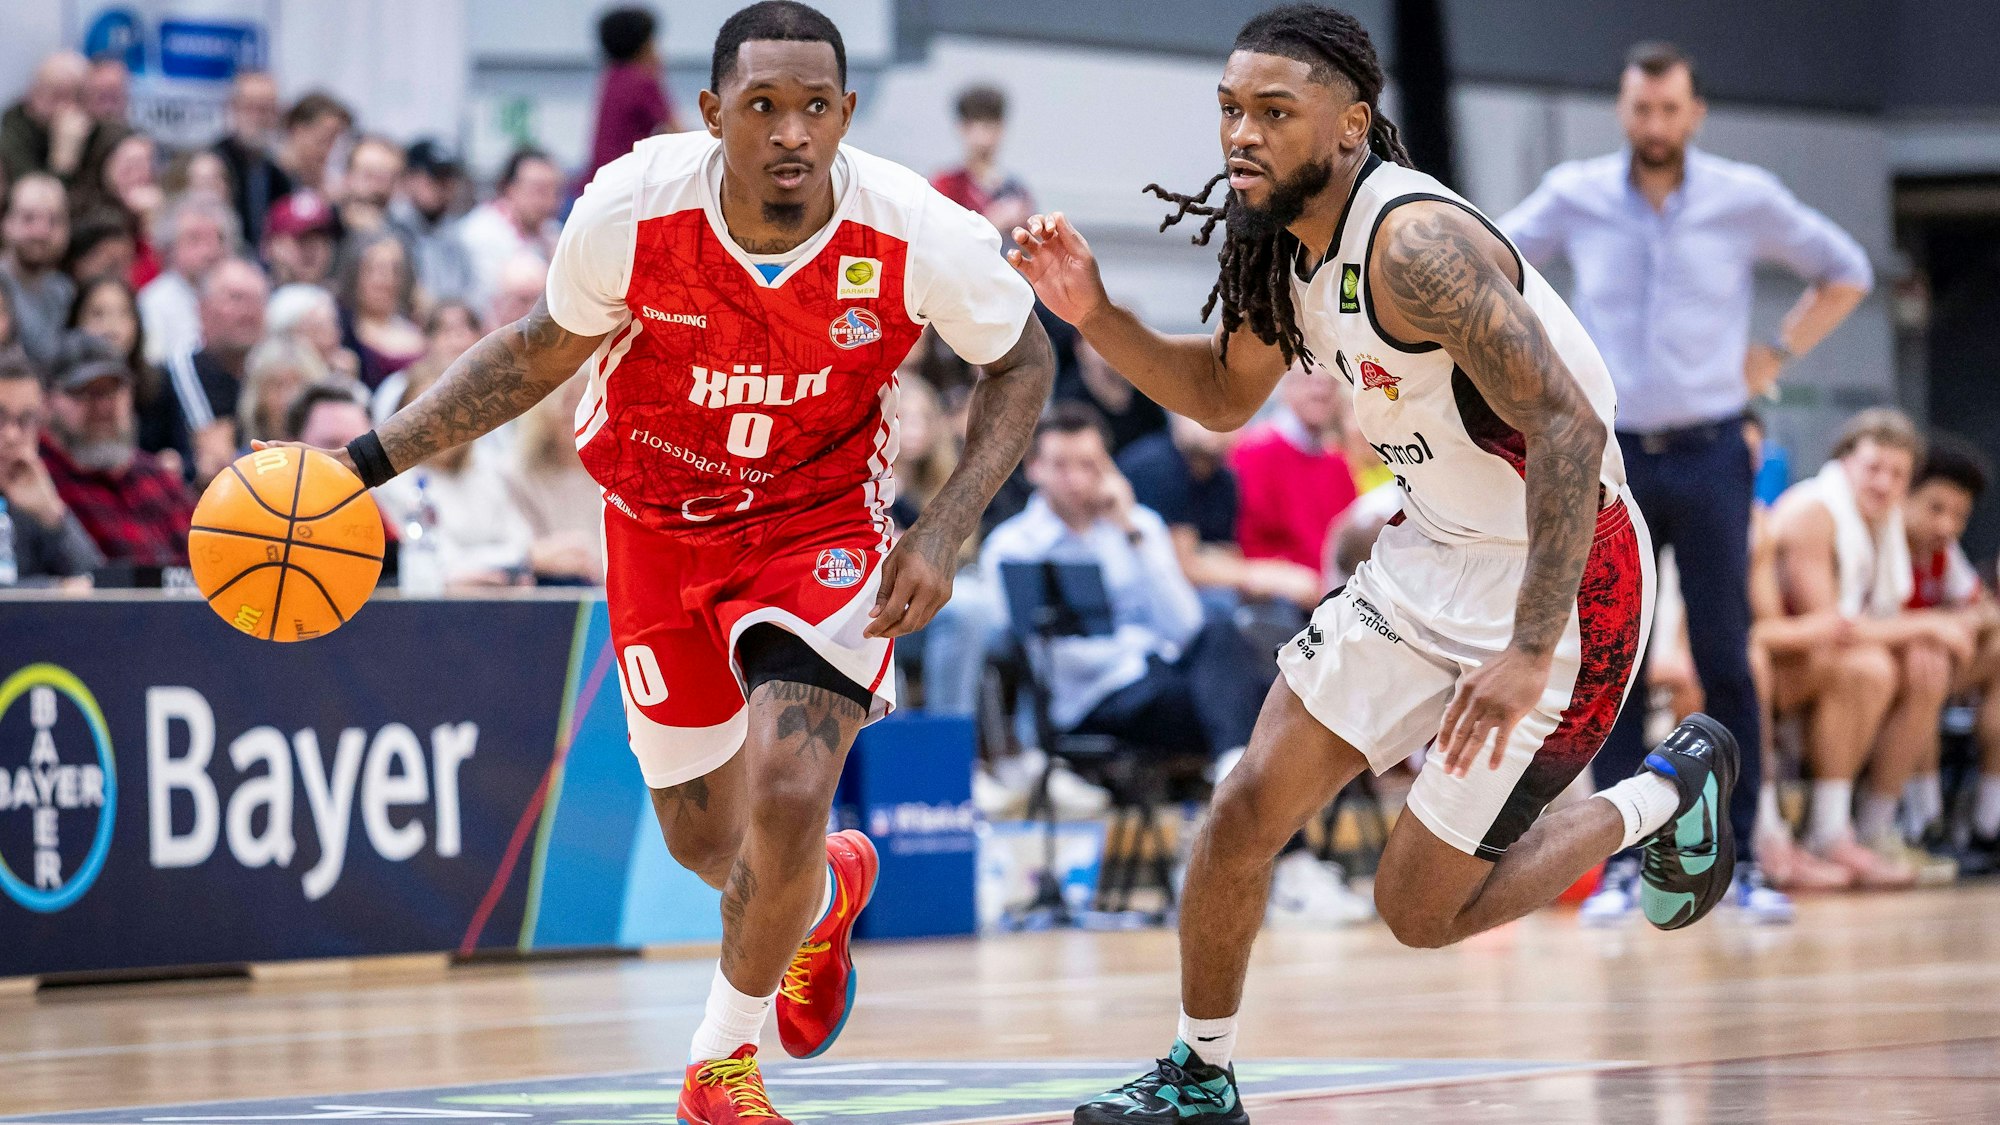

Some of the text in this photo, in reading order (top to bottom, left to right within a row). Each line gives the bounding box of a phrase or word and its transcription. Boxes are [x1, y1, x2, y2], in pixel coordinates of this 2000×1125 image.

[642, 305, 708, 329] SPALDING
[831, 325, 865, 336] RHEIN
[846, 328, 881, 341] STARS
[687, 364, 834, 410] KÖLN
[726, 411, 775, 460] 0
[828, 568, 861, 578] STARS
[623, 644, 669, 707] 0
[146, 685, 480, 901] Bayer
